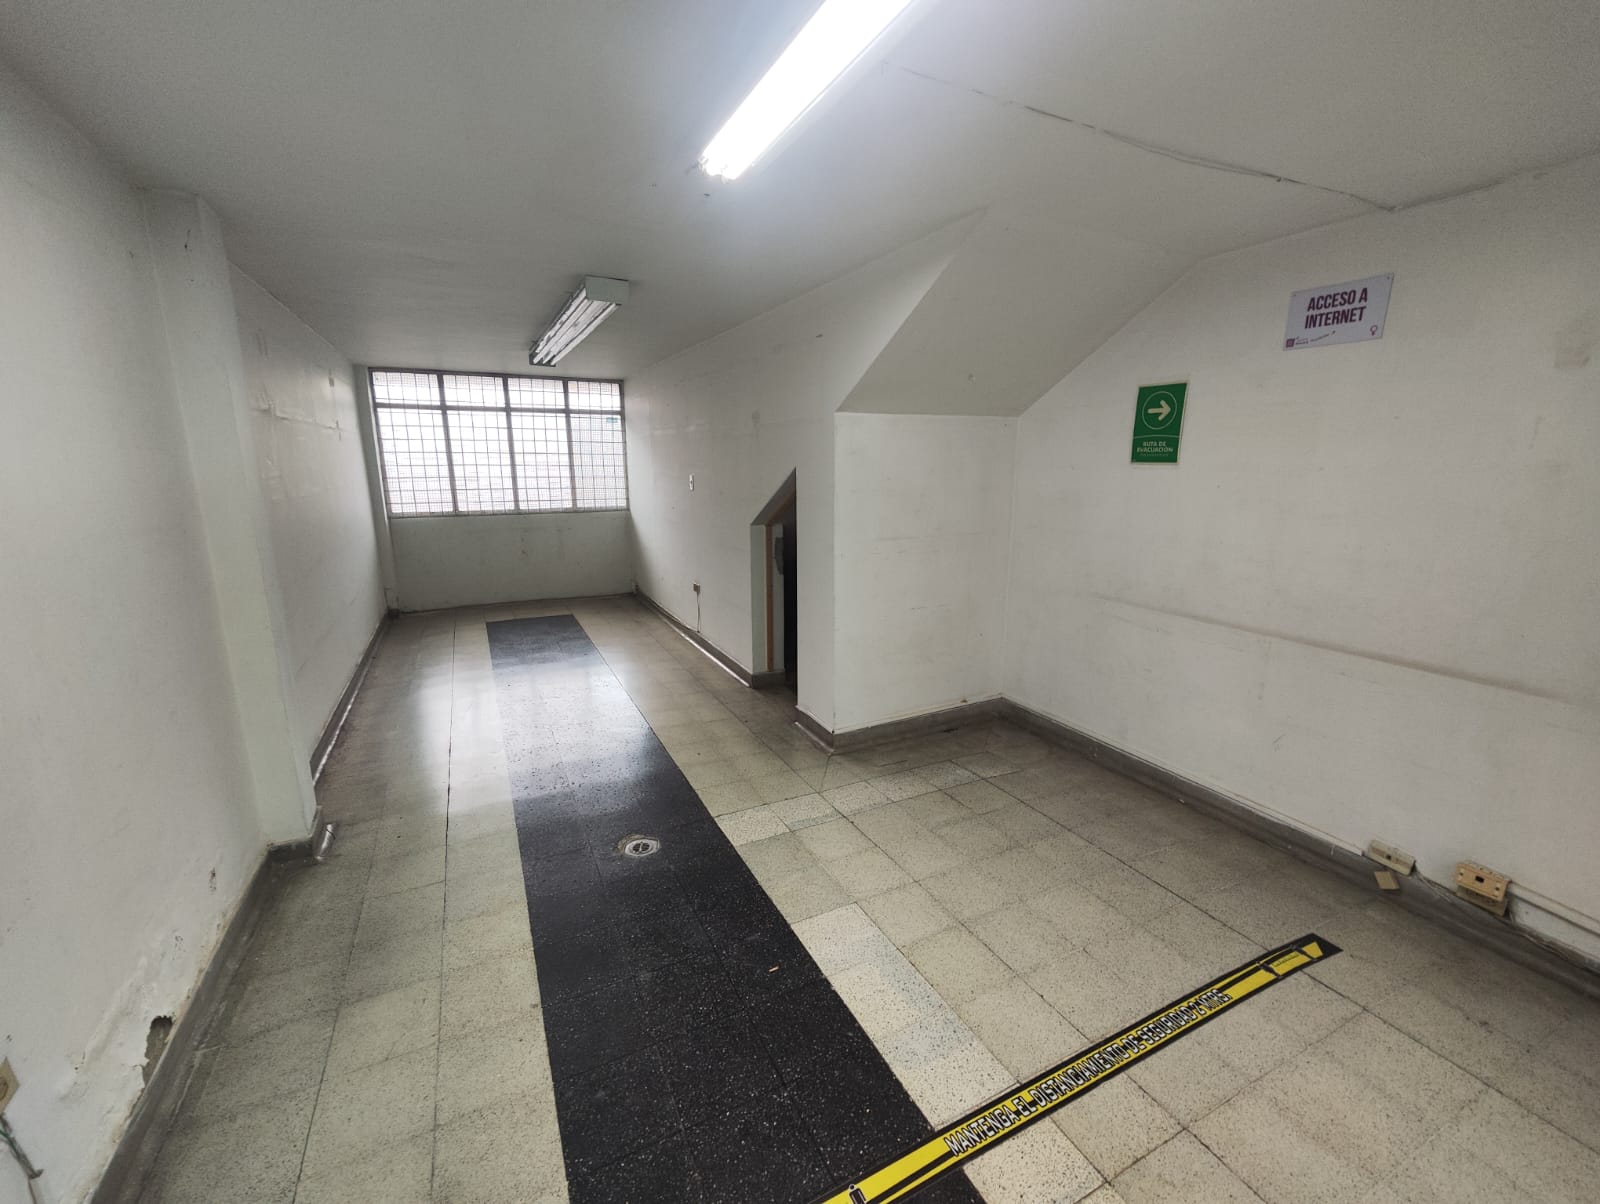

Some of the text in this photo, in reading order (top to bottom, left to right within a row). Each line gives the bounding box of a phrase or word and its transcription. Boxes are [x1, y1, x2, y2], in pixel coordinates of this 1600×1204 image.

[1307, 287, 1368, 312] ACCESO A
[1304, 306, 1367, 329] INTERNET
[944, 1104, 1019, 1156] MANTENGA
[1013, 1096, 1037, 1116] EL
[1029, 1044, 1130, 1107] DISTANCIAMIENTO
[1121, 1035, 1146, 1054] DE
[1137, 1005, 1197, 1044] SEGURIDAD
[1189, 1001, 1206, 1015] 2
